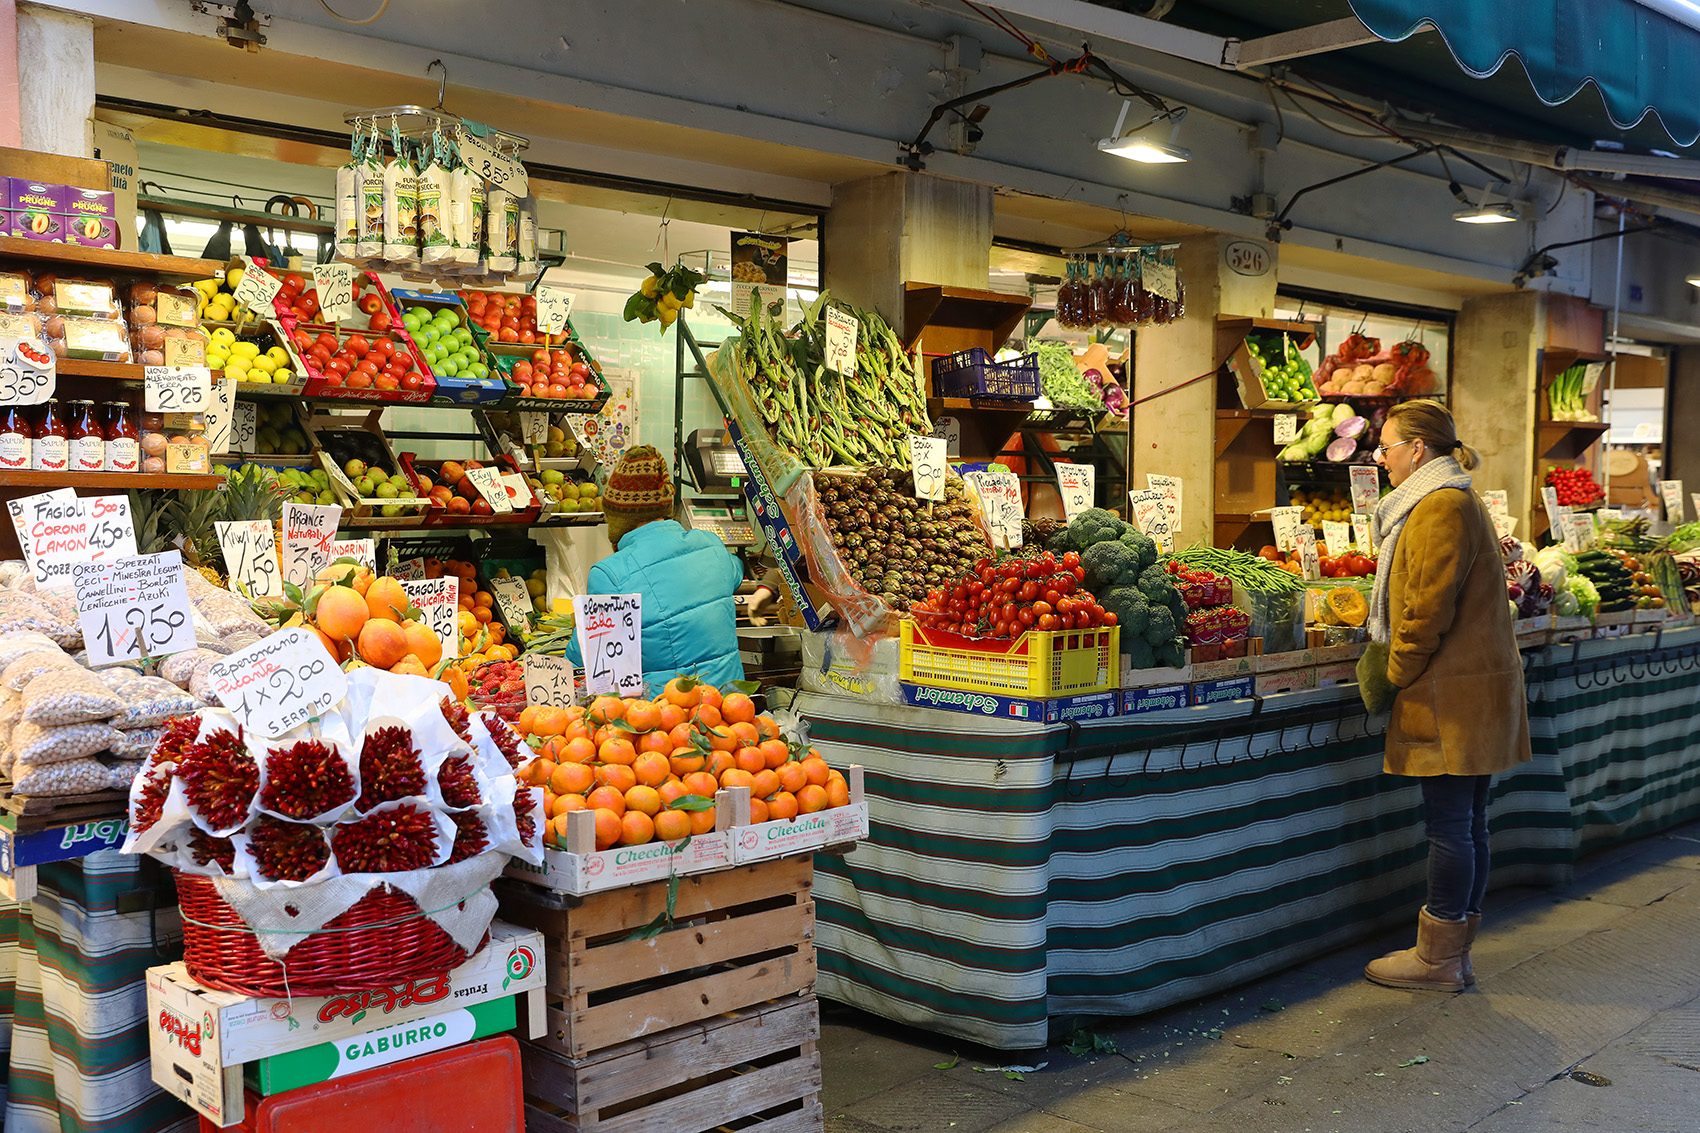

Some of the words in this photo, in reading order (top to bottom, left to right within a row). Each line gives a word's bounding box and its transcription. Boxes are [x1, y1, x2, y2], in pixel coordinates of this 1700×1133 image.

[19, 196, 57, 207] PRUGNE
[72, 202, 108, 213] PRUGNE
[516, 399, 591, 410] MelaPiù
[736, 437, 780, 519] Schembri
[91, 498, 118, 519] 500
[31, 521, 87, 539] CORONA
[35, 537, 87, 557] LAMON
[72, 563, 105, 577] ORZO
[765, 524, 810, 612] Schembri
[915, 686, 999, 714] Schembri
[1060, 702, 1105, 720] Schembri
[767, 817, 825, 841] Checchin
[615, 843, 684, 866] Checchi
[453, 984, 489, 999] Frutas
[158, 1008, 202, 1058] Pitiso
[345, 1021, 448, 1061] GABURRO
